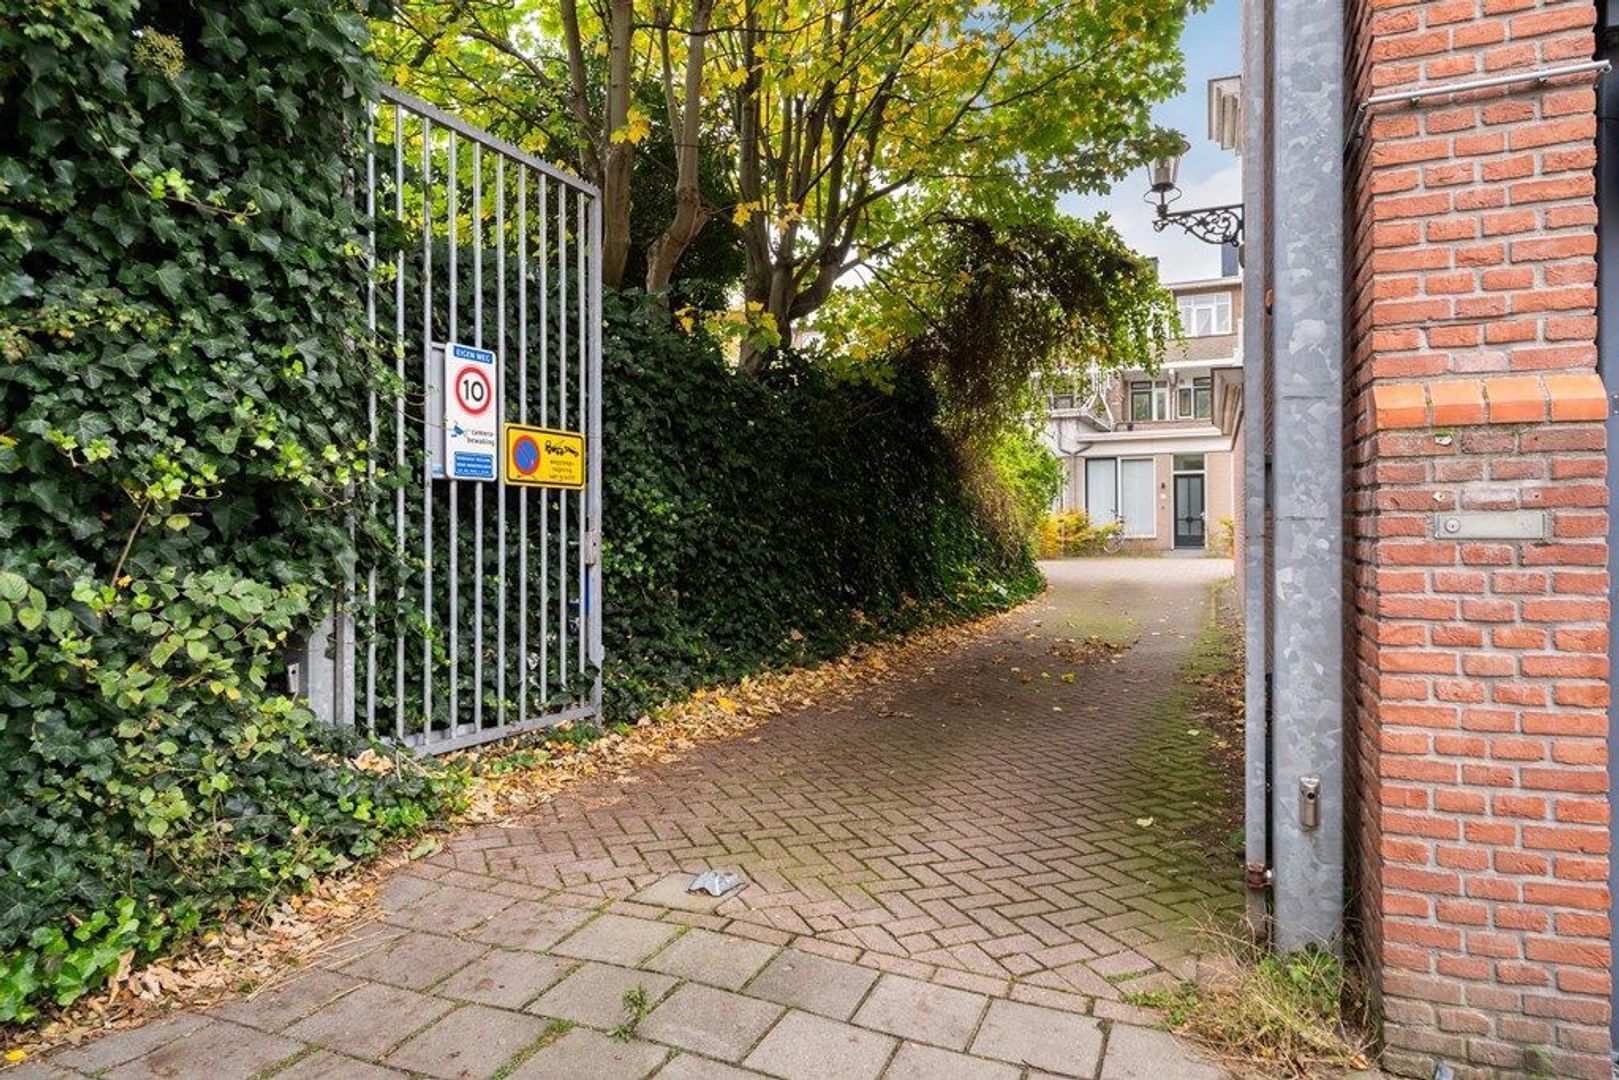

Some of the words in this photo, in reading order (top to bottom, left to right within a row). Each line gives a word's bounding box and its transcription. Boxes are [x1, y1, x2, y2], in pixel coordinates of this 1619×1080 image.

[456, 348, 475, 359] EIGEN
[476, 352, 491, 363] WEG
[463, 379, 484, 402] 10
